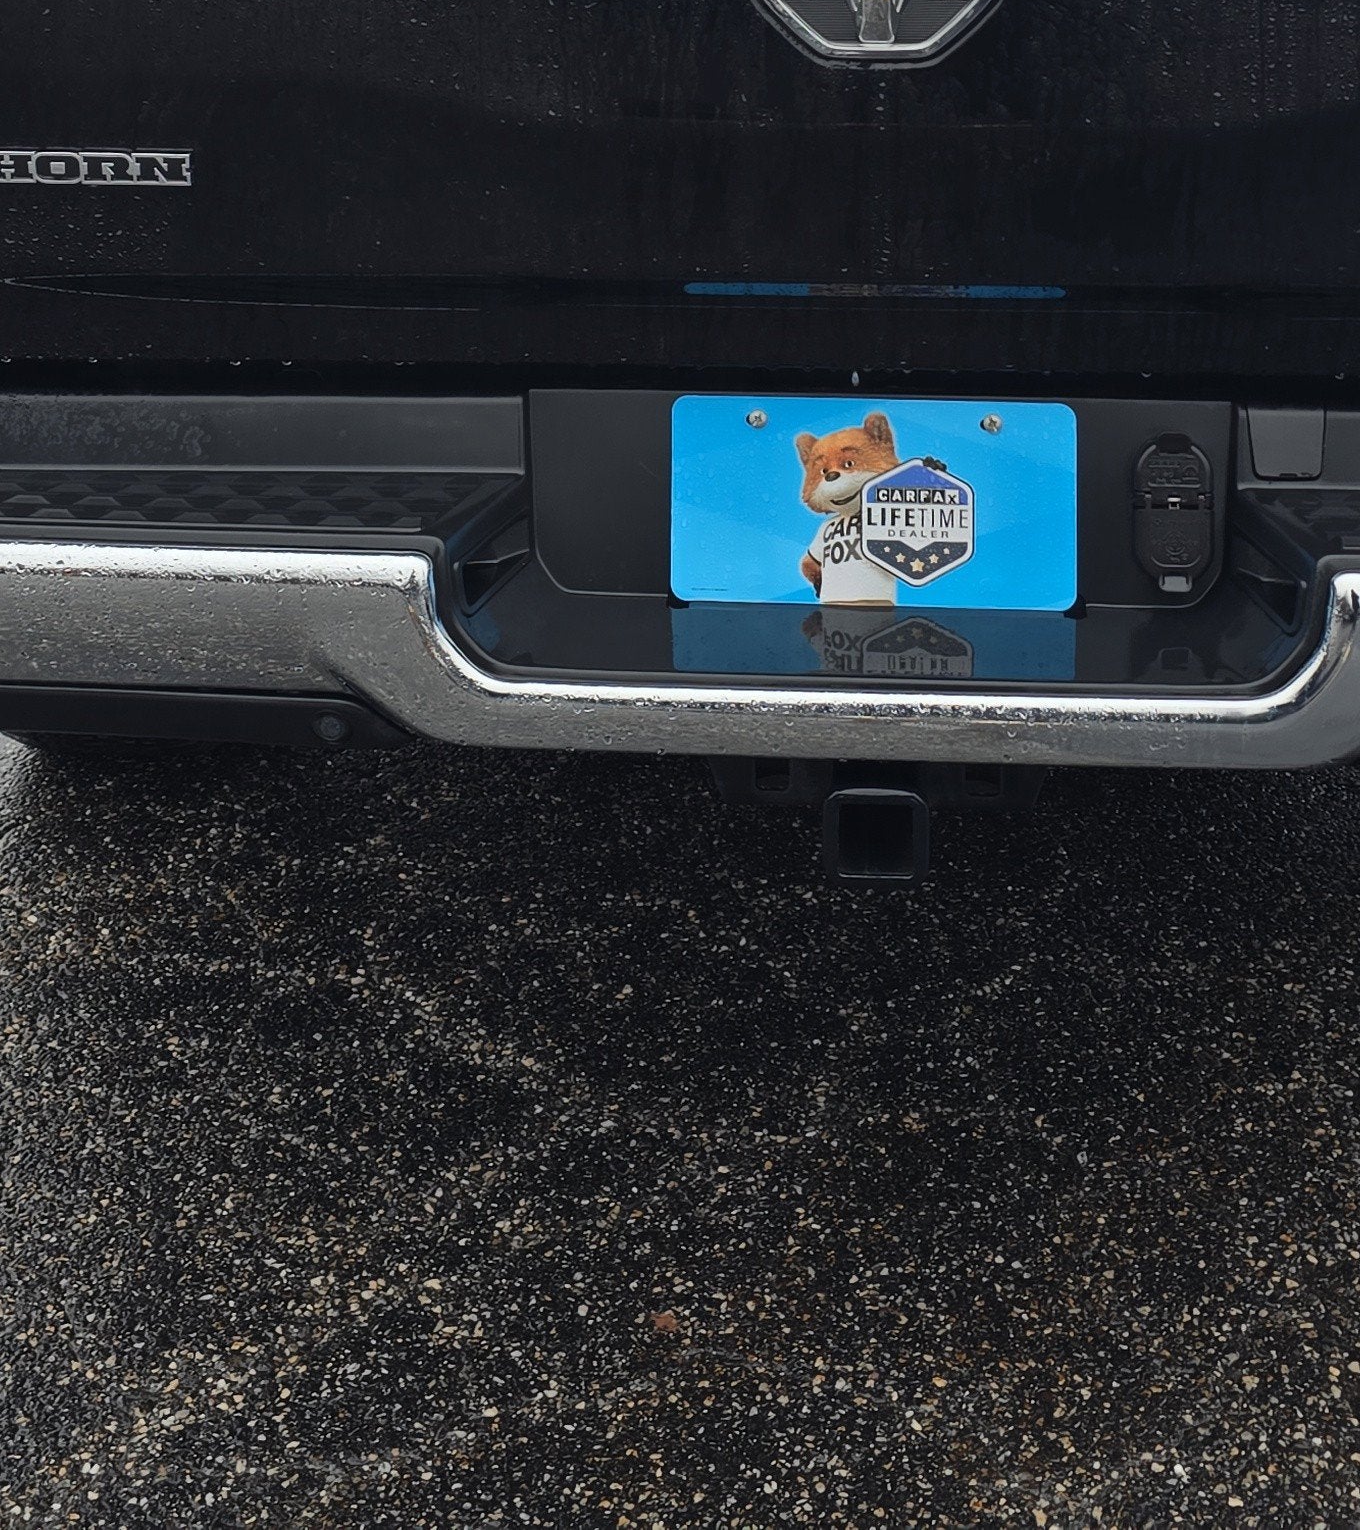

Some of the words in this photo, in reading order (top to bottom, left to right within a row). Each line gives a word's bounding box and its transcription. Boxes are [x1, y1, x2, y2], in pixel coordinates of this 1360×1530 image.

[877, 488, 959, 505] CARFAX
[823, 515, 862, 543] CAR
[866, 507, 969, 529] LIFETIME
[887, 529, 950, 539] DEALER
[822, 537, 863, 569] FOX
